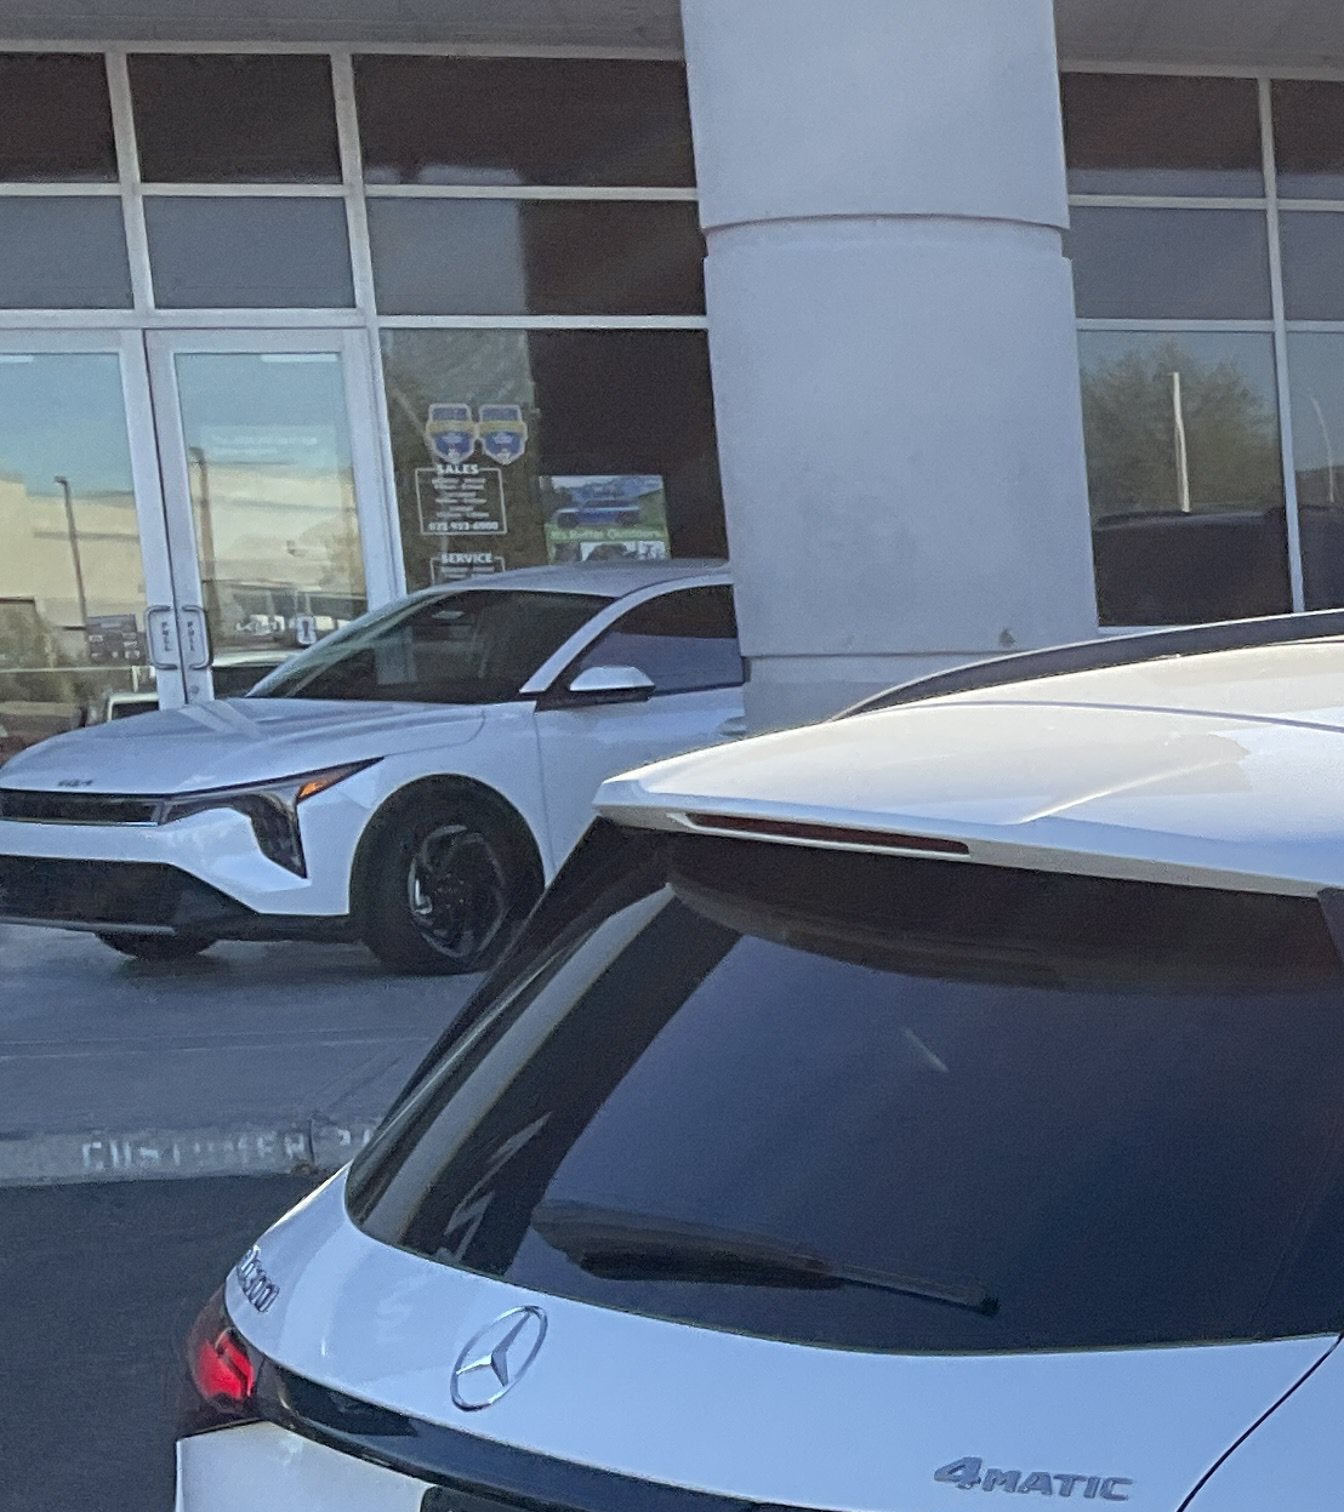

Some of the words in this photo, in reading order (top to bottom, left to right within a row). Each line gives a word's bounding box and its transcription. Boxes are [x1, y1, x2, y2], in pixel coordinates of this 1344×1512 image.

[436, 463, 479, 475] SALES
[441, 552, 493, 564] SERVICE
[933, 1456, 1133, 1501] 4MATIC
